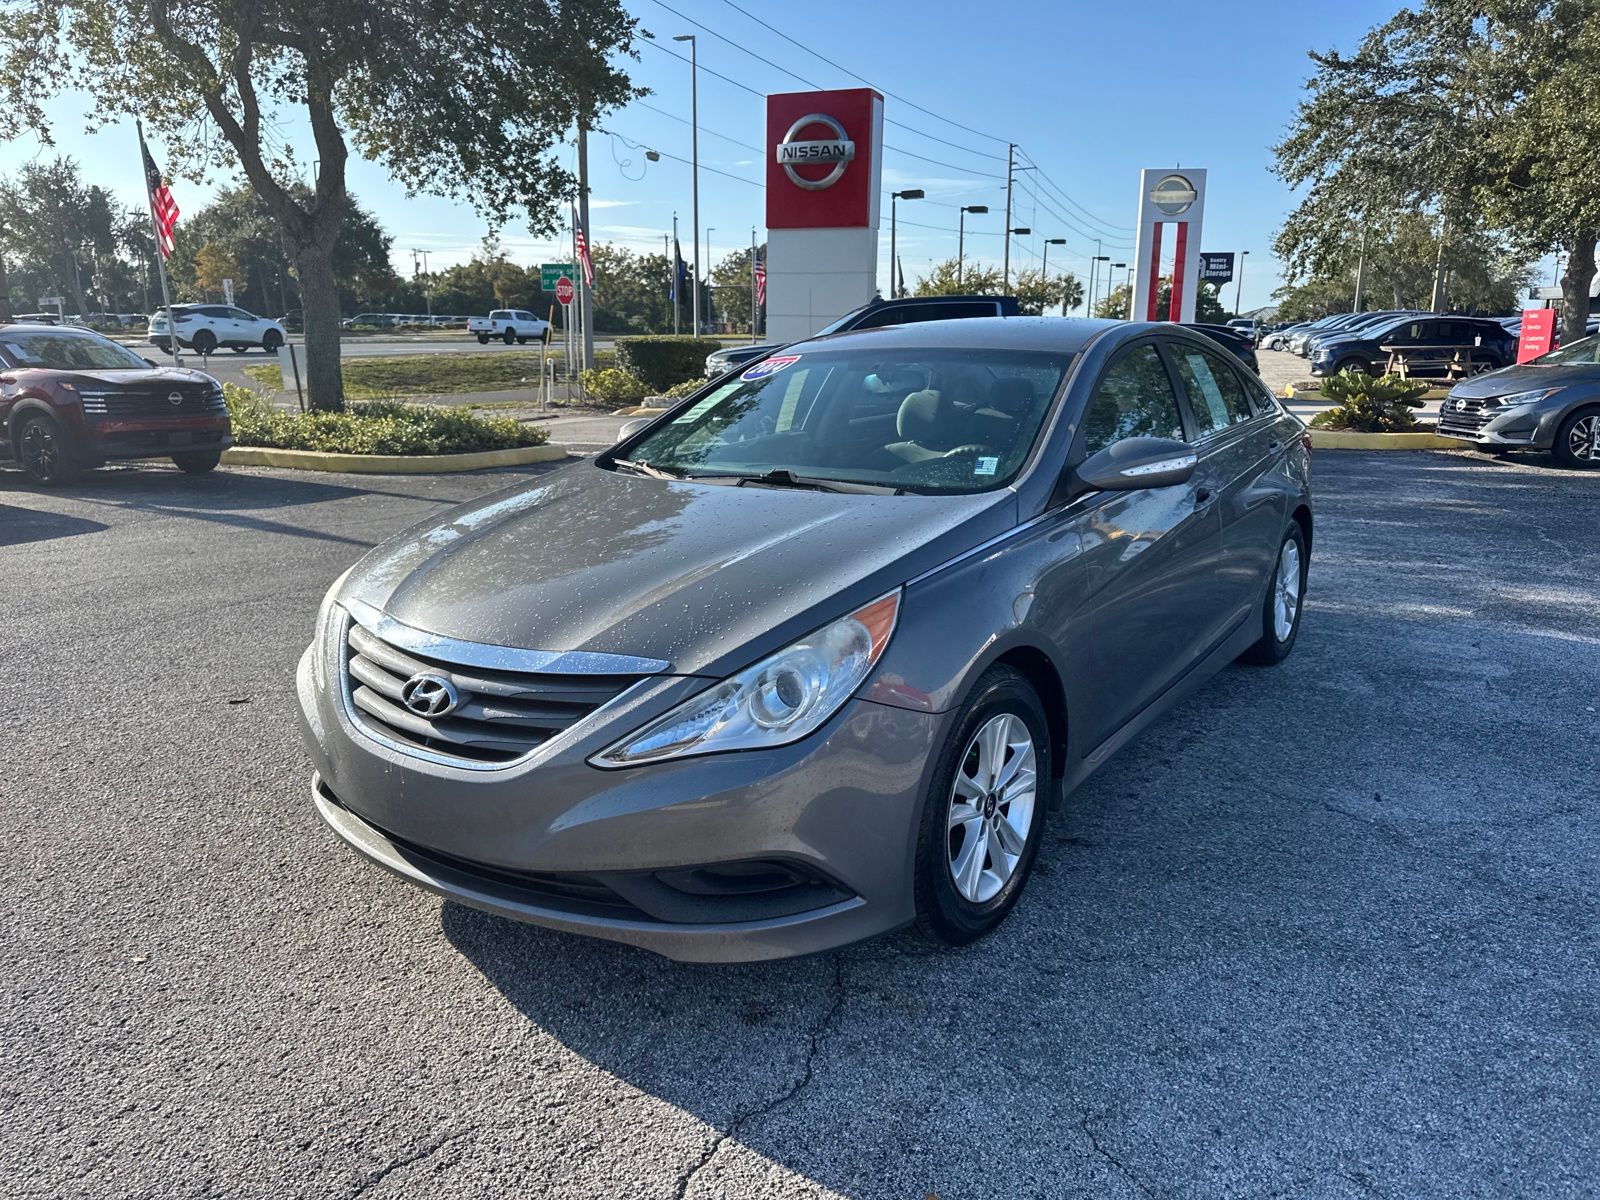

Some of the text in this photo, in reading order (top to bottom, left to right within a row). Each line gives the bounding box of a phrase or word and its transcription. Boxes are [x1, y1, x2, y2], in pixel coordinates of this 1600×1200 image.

[783, 145, 845, 159] NISSAN
[1205, 269, 1231, 277] Storage
[557, 285, 572, 297] STOP
